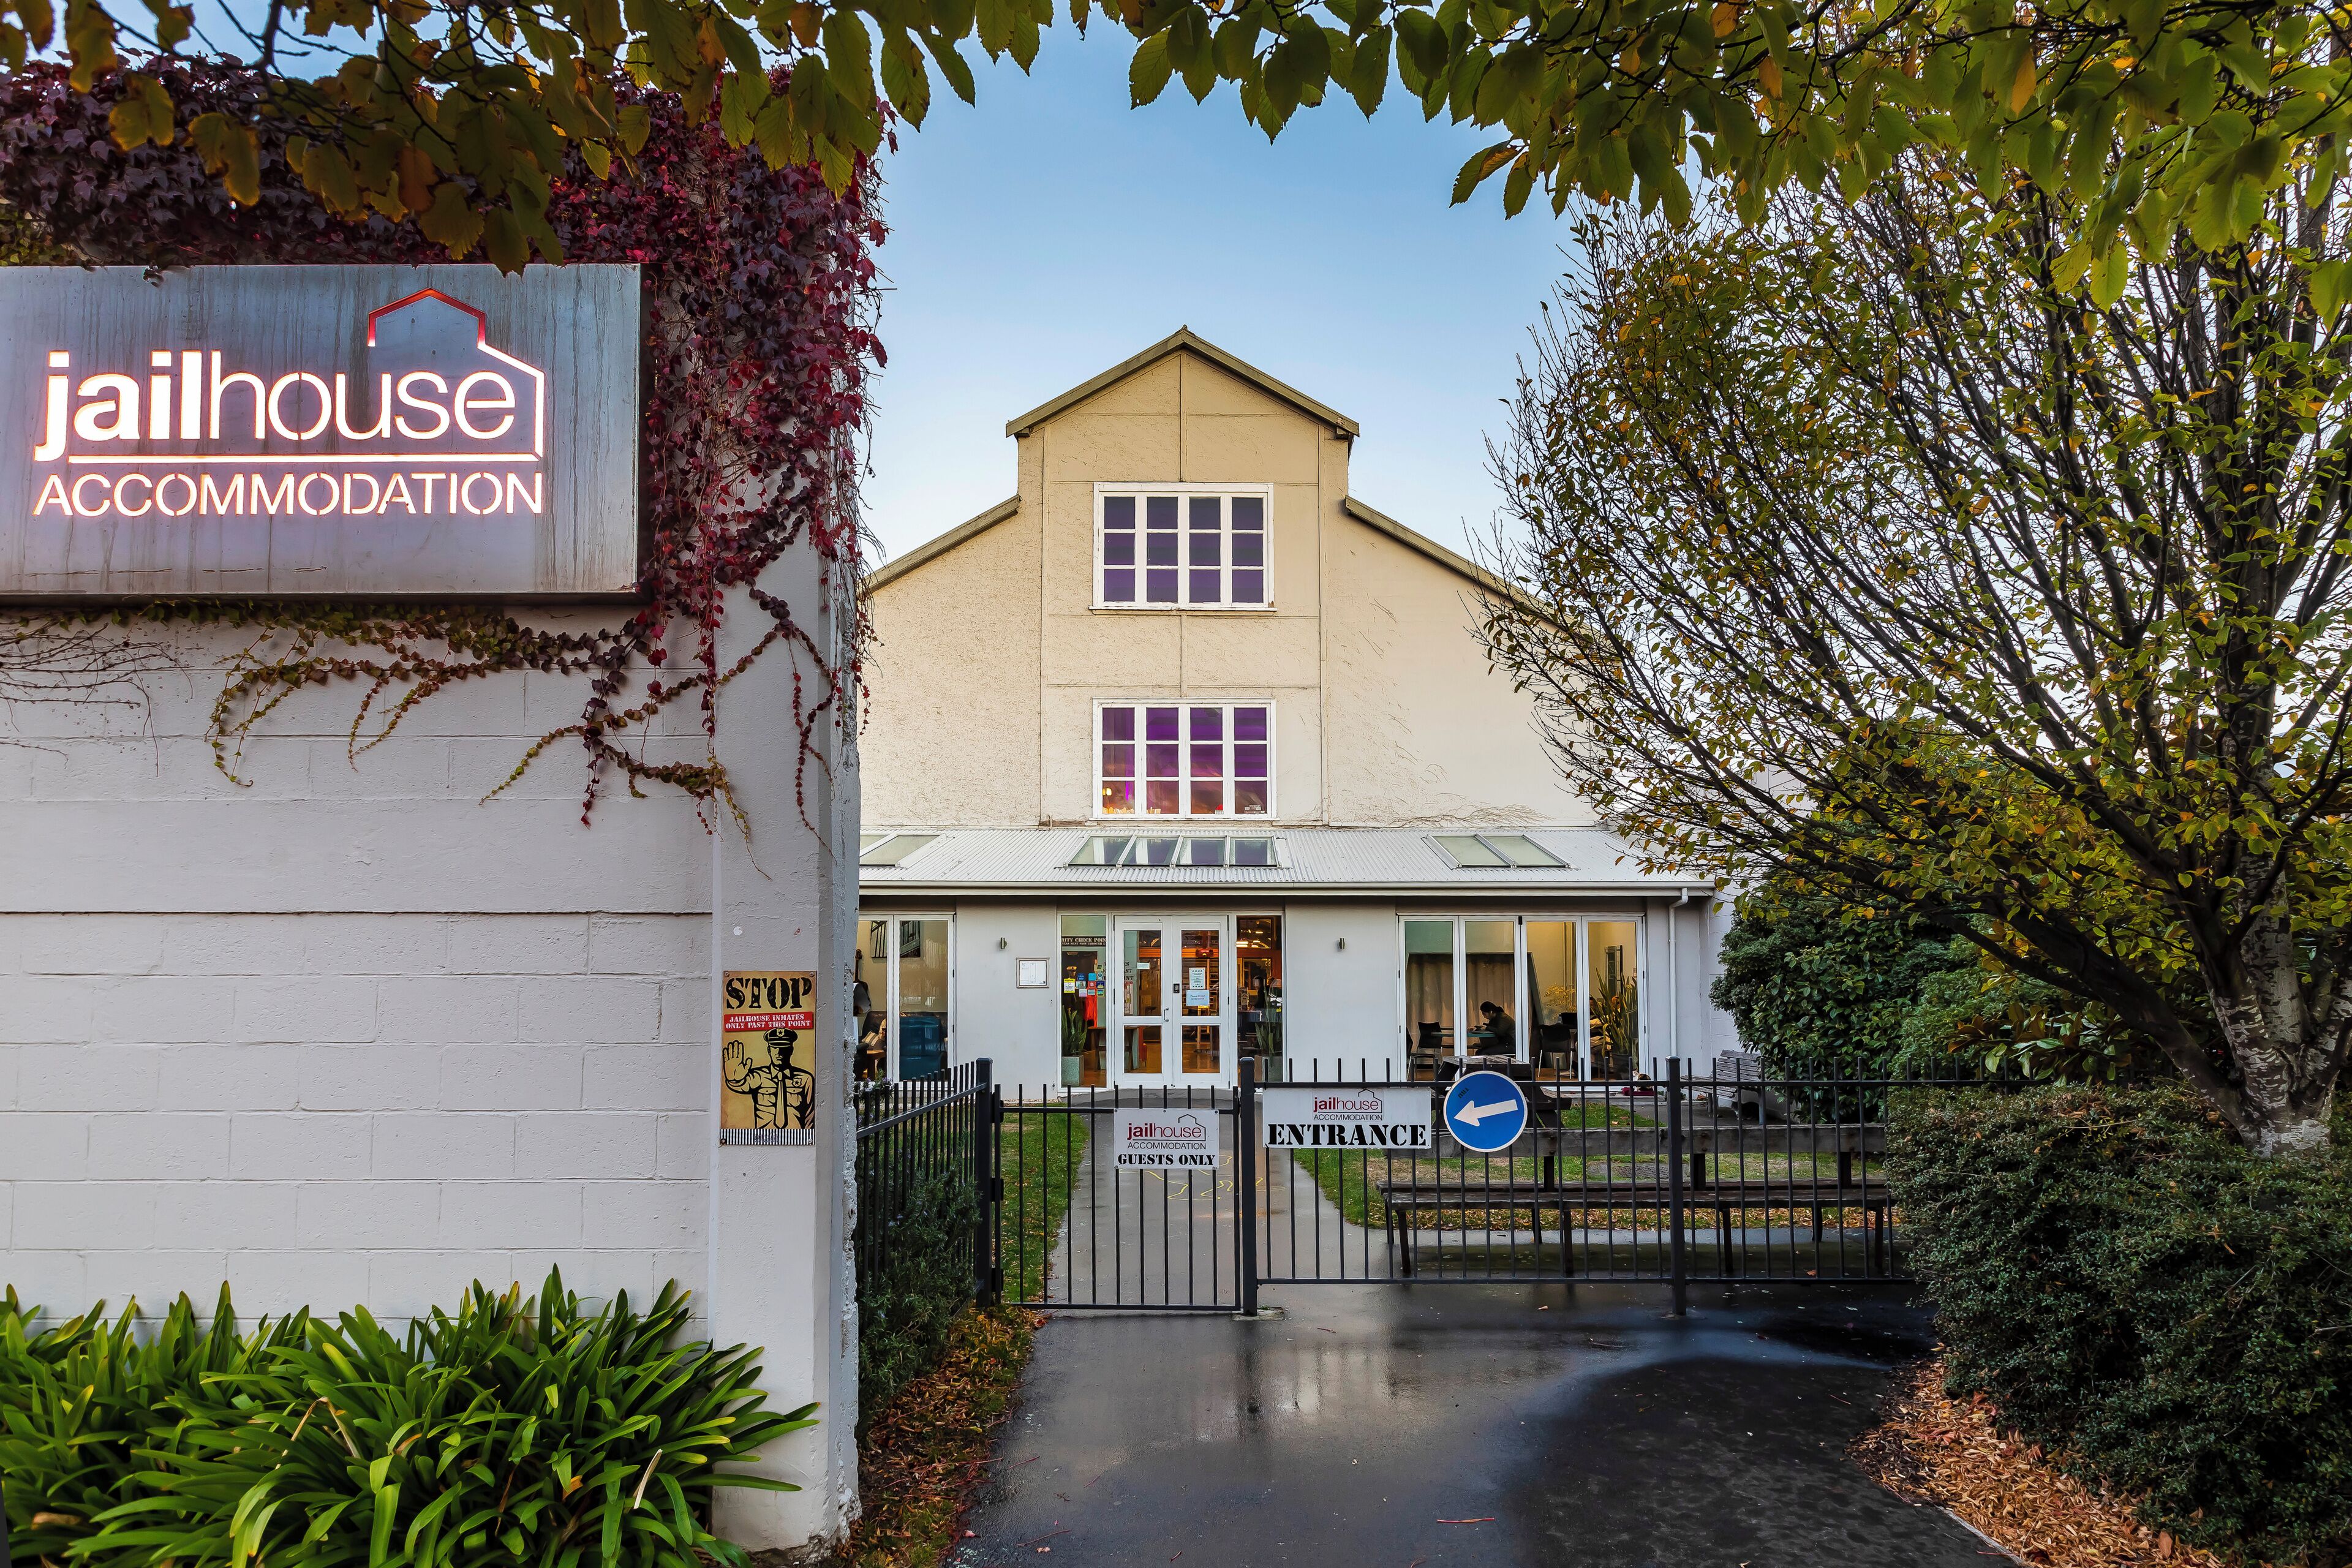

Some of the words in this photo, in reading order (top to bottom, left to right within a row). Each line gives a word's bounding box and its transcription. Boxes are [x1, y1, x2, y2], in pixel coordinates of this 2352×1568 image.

[33, 350, 516, 462] jailhouse
[32, 472, 543, 517] ACCOMMODATION
[726, 977, 812, 1009] STOP
[1313, 1097, 1379, 1113] jailhouse
[1126, 1123, 1202, 1140] jailhouse
[1267, 1123, 1427, 1146] ENTRANCE
[1118, 1153, 1174, 1166] GUESTS
[1178, 1154, 1216, 1166] ONLY
